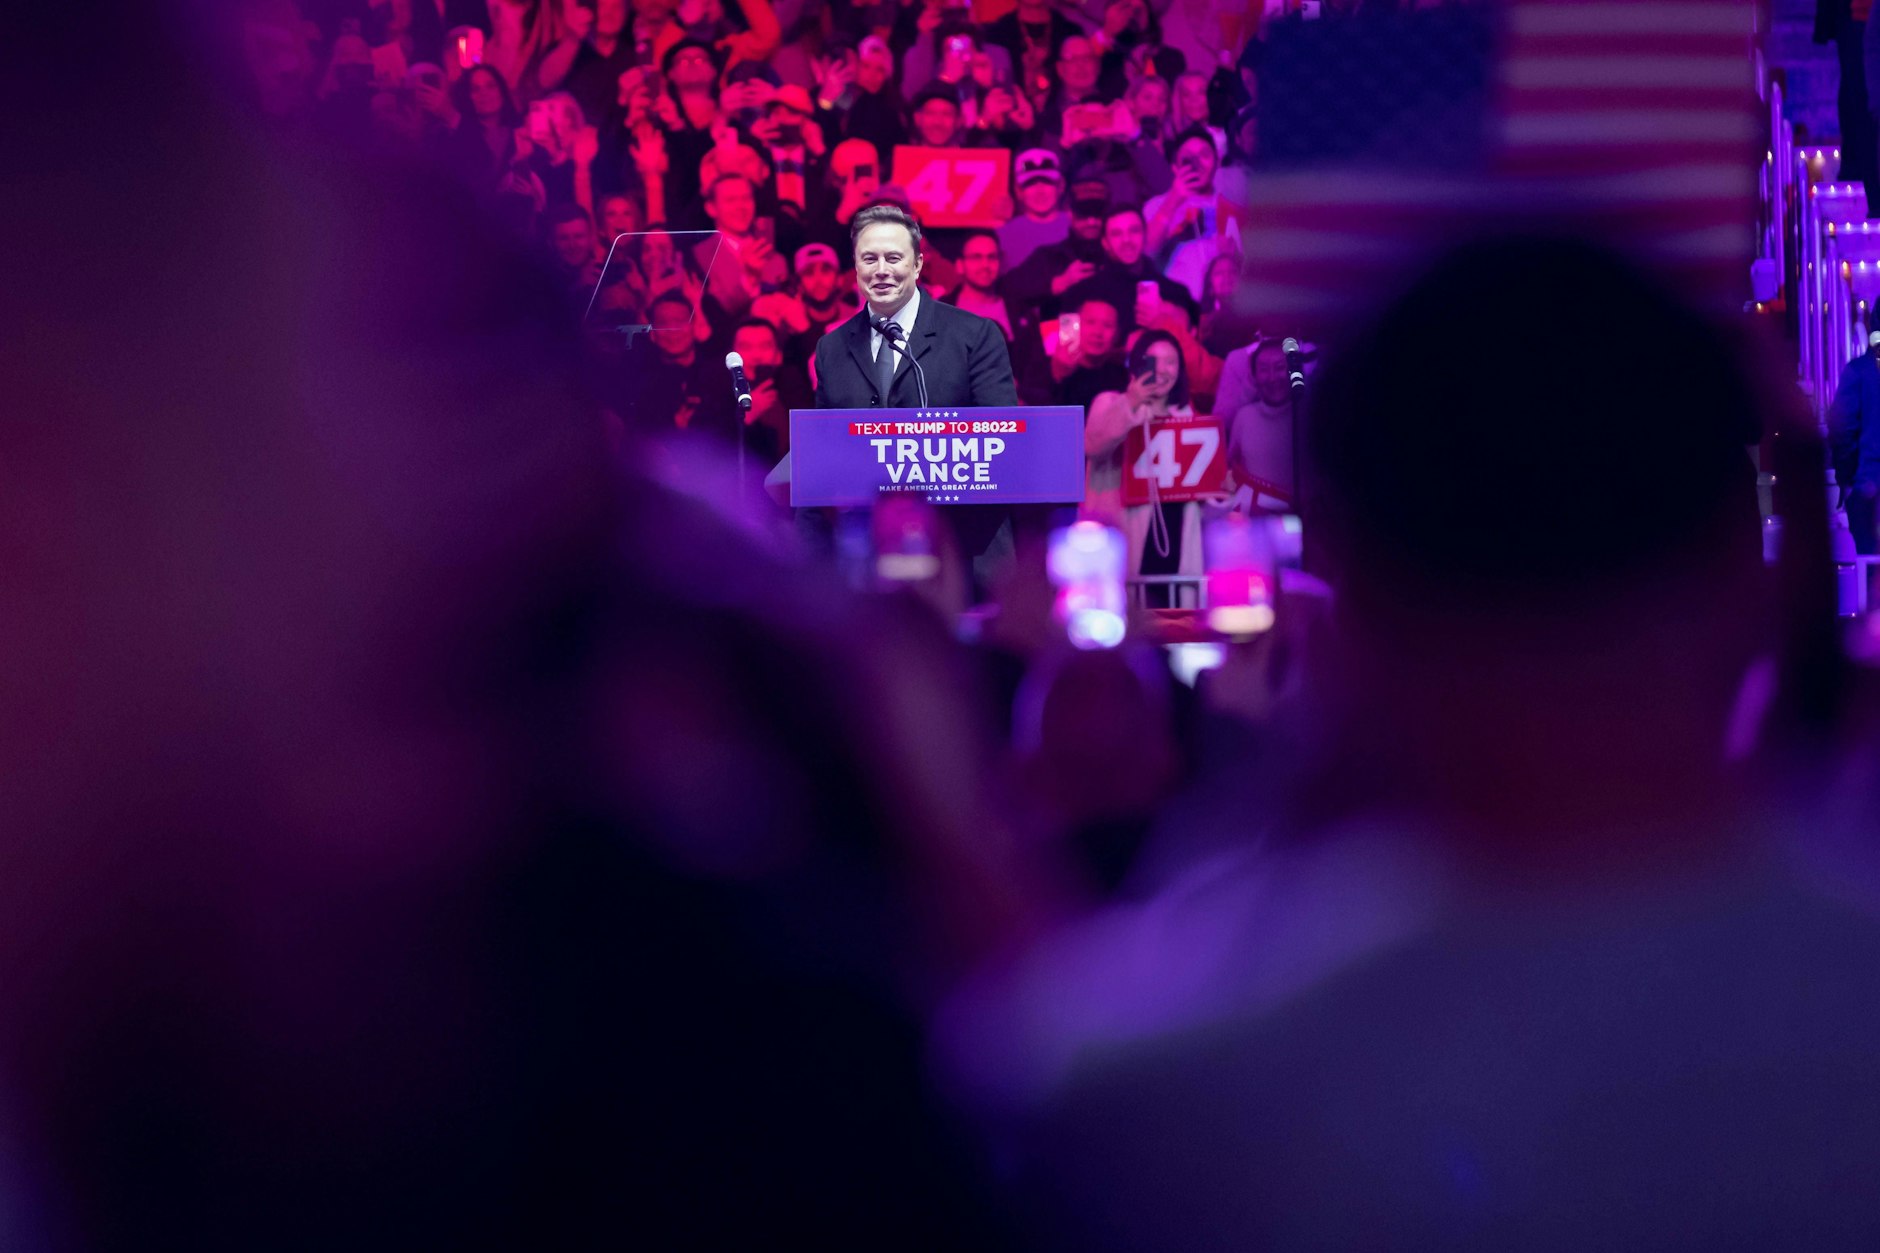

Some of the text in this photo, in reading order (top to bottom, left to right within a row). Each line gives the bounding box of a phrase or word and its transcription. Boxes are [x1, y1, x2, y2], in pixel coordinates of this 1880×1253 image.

[906, 160, 996, 213] 47
[855, 421, 1017, 435] TEXT TRUMP TO 88022
[870, 437, 1005, 463] TRUMP
[1133, 427, 1219, 488] 47
[885, 462, 990, 483] VANCE
